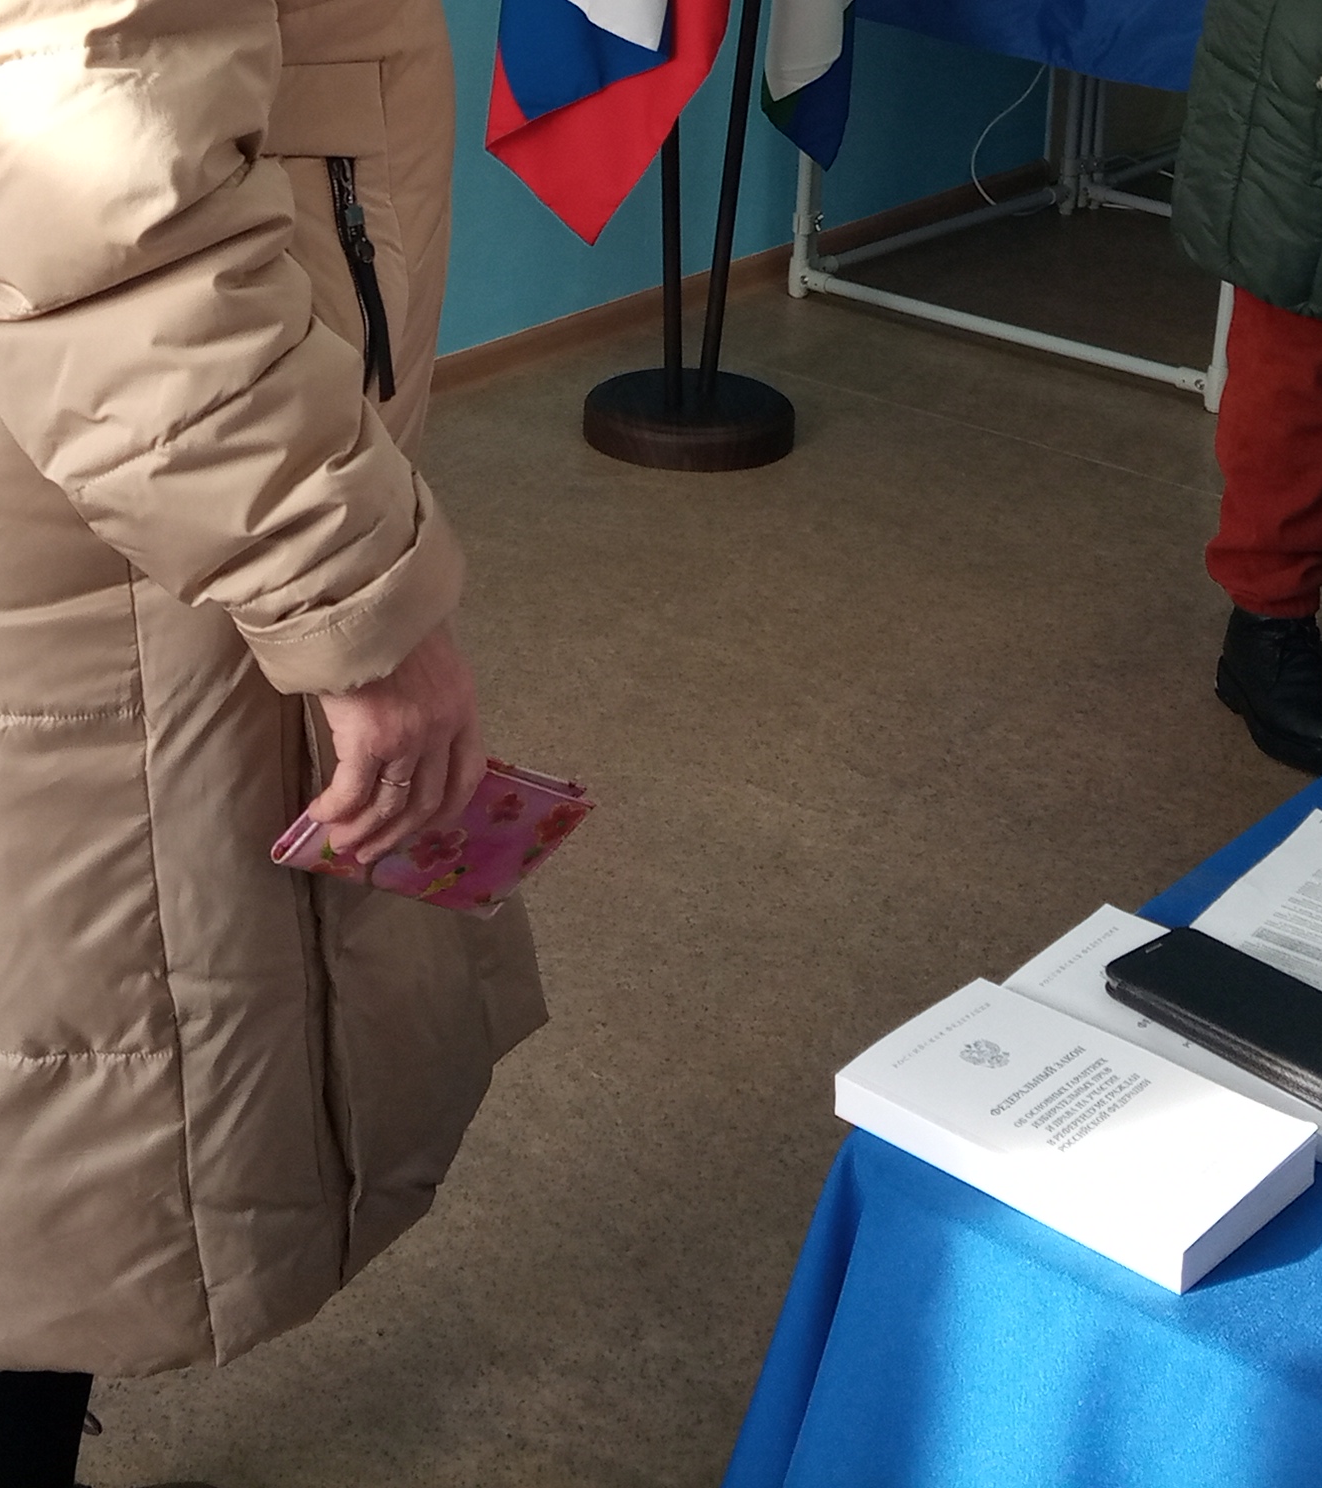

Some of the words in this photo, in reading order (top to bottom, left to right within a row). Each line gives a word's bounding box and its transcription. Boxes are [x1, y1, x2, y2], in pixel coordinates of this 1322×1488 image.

[988, 1063, 1058, 1119] ФЕДЕРАЛЬНЫЙ
[1054, 1043, 1087, 1071] ЗАКОН
[1012, 1114, 1028, 1130] ОБ
[1024, 1084, 1069, 1121] ОСНОВНЫХ
[1065, 1055, 1109, 1091] ГАРАНТИЯХ
[1030, 1078, 1095, 1130] ИЗБИРАТЕЛЬНЫХ
[1091, 1064, 1113, 1085] ПРАВ
[1044, 1122, 1055, 1134] И
[1052, 1104, 1078, 1128] ПРАВА
[1075, 1095, 1090, 1111] НА
[1087, 1072, 1121, 1102] УЧАСТИЕ
[1053, 1096, 1109, 1143] РЕФЕРЕНДУМЕ
[1105, 1071, 1142, 1103] ГРАЖДАН
[1056, 1109, 1111, 1155] РОССИЙСКОЙ
[1107, 1076, 1152, 1116] ФЕДЕРАЦИИ
